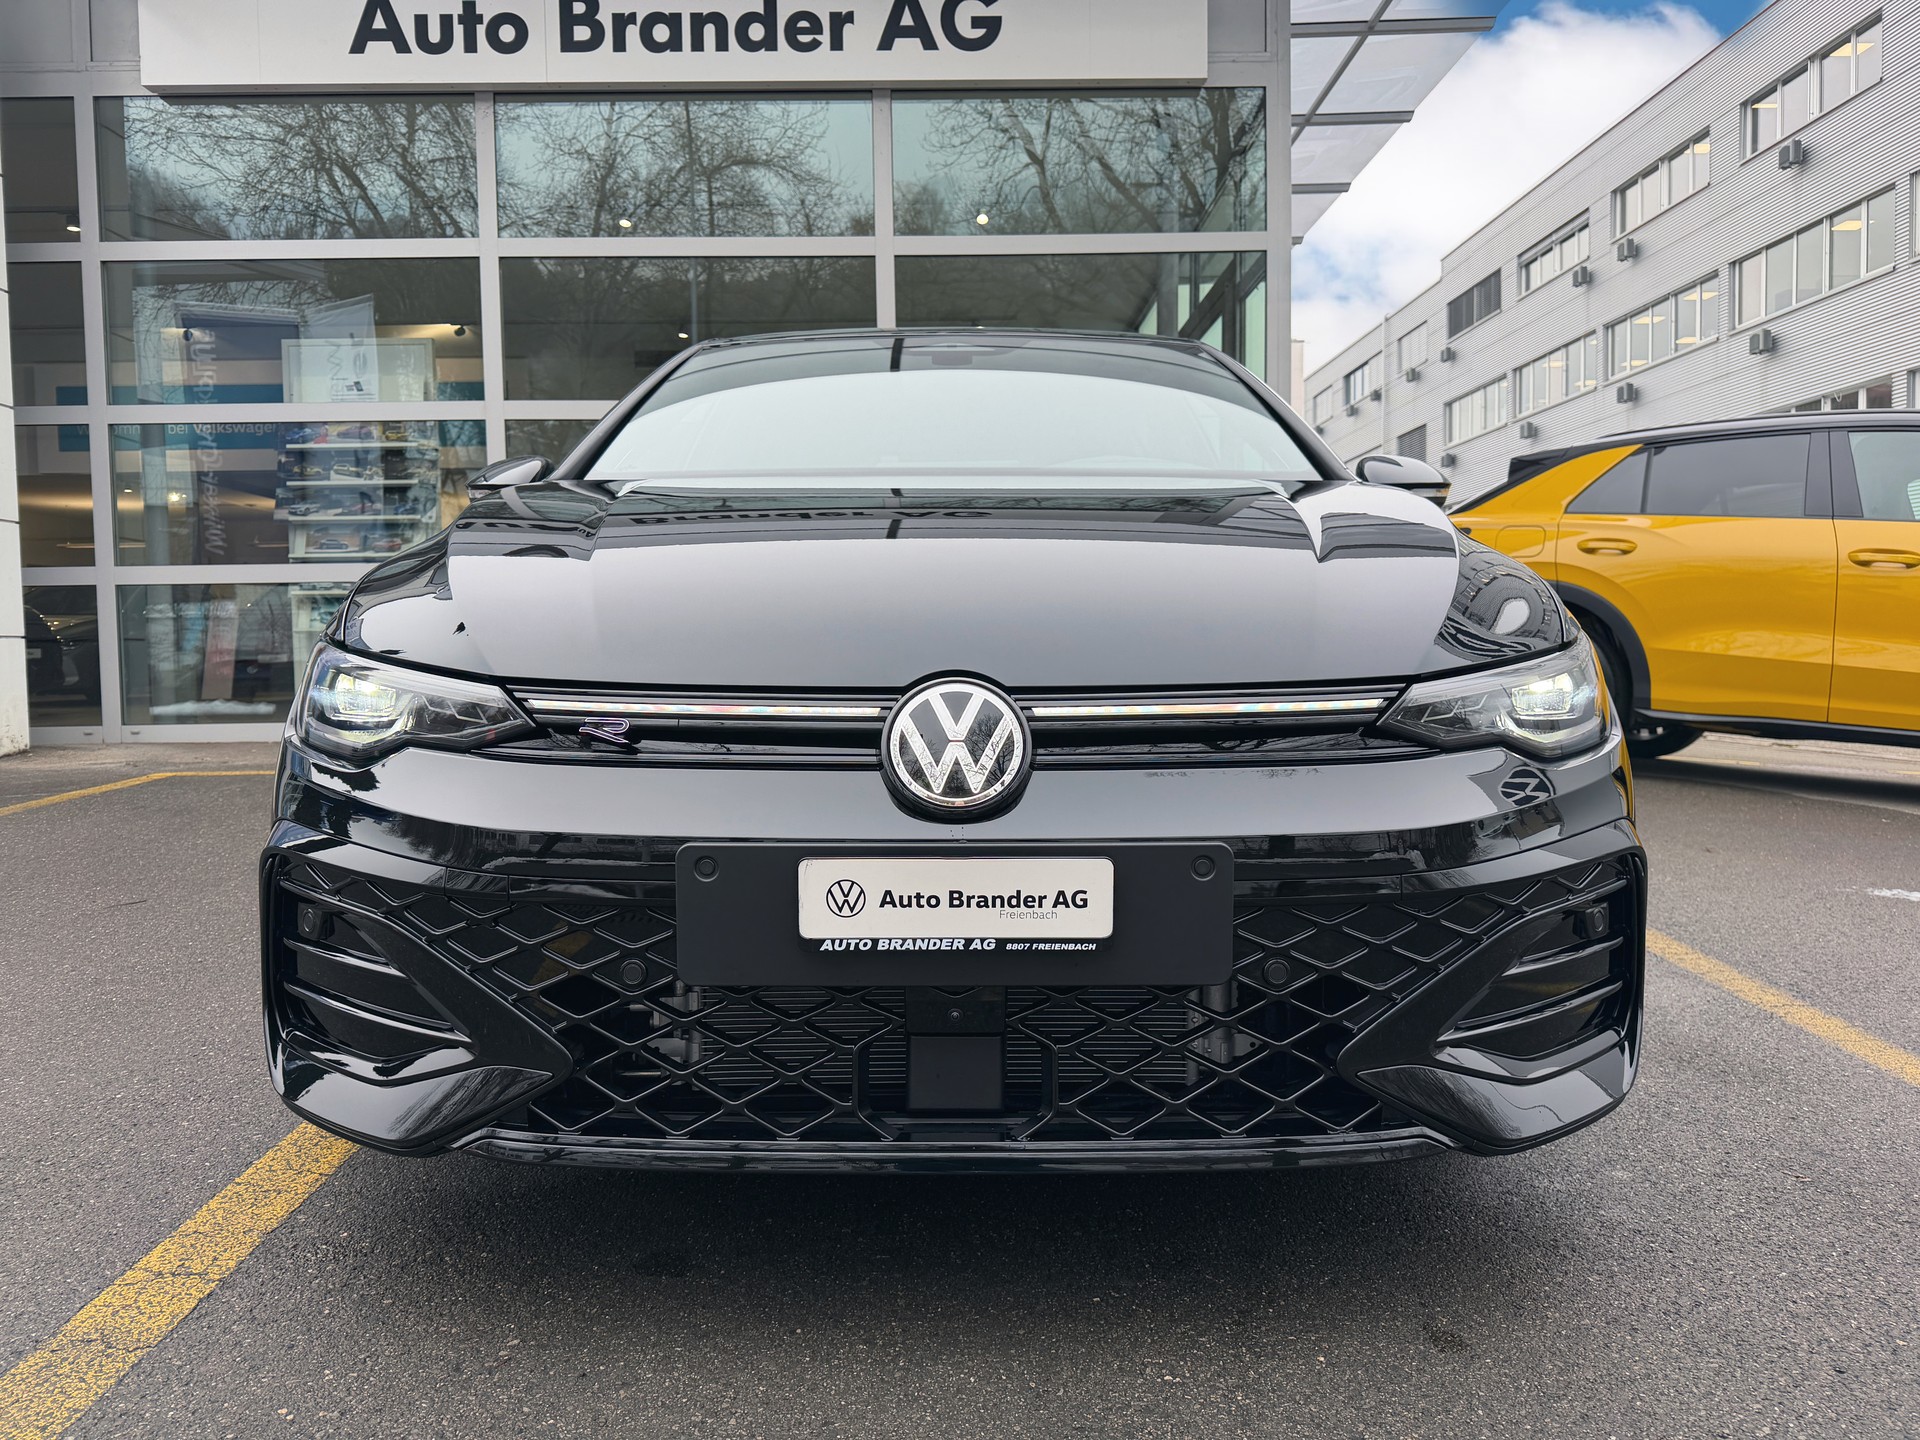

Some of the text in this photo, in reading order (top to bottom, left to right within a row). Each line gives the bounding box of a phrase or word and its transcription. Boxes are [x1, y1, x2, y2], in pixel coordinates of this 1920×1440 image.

[349, 0, 1003, 55] Auto Brander AG
[879, 890, 941, 909] Auto
[949, 890, 1047, 909] Brander
[1052, 890, 1089, 909] AG
[1000, 909, 1058, 920] Freienbach
[820, 938, 1097, 951] AUTO BRANDER AG 8807 FREIENBACH
